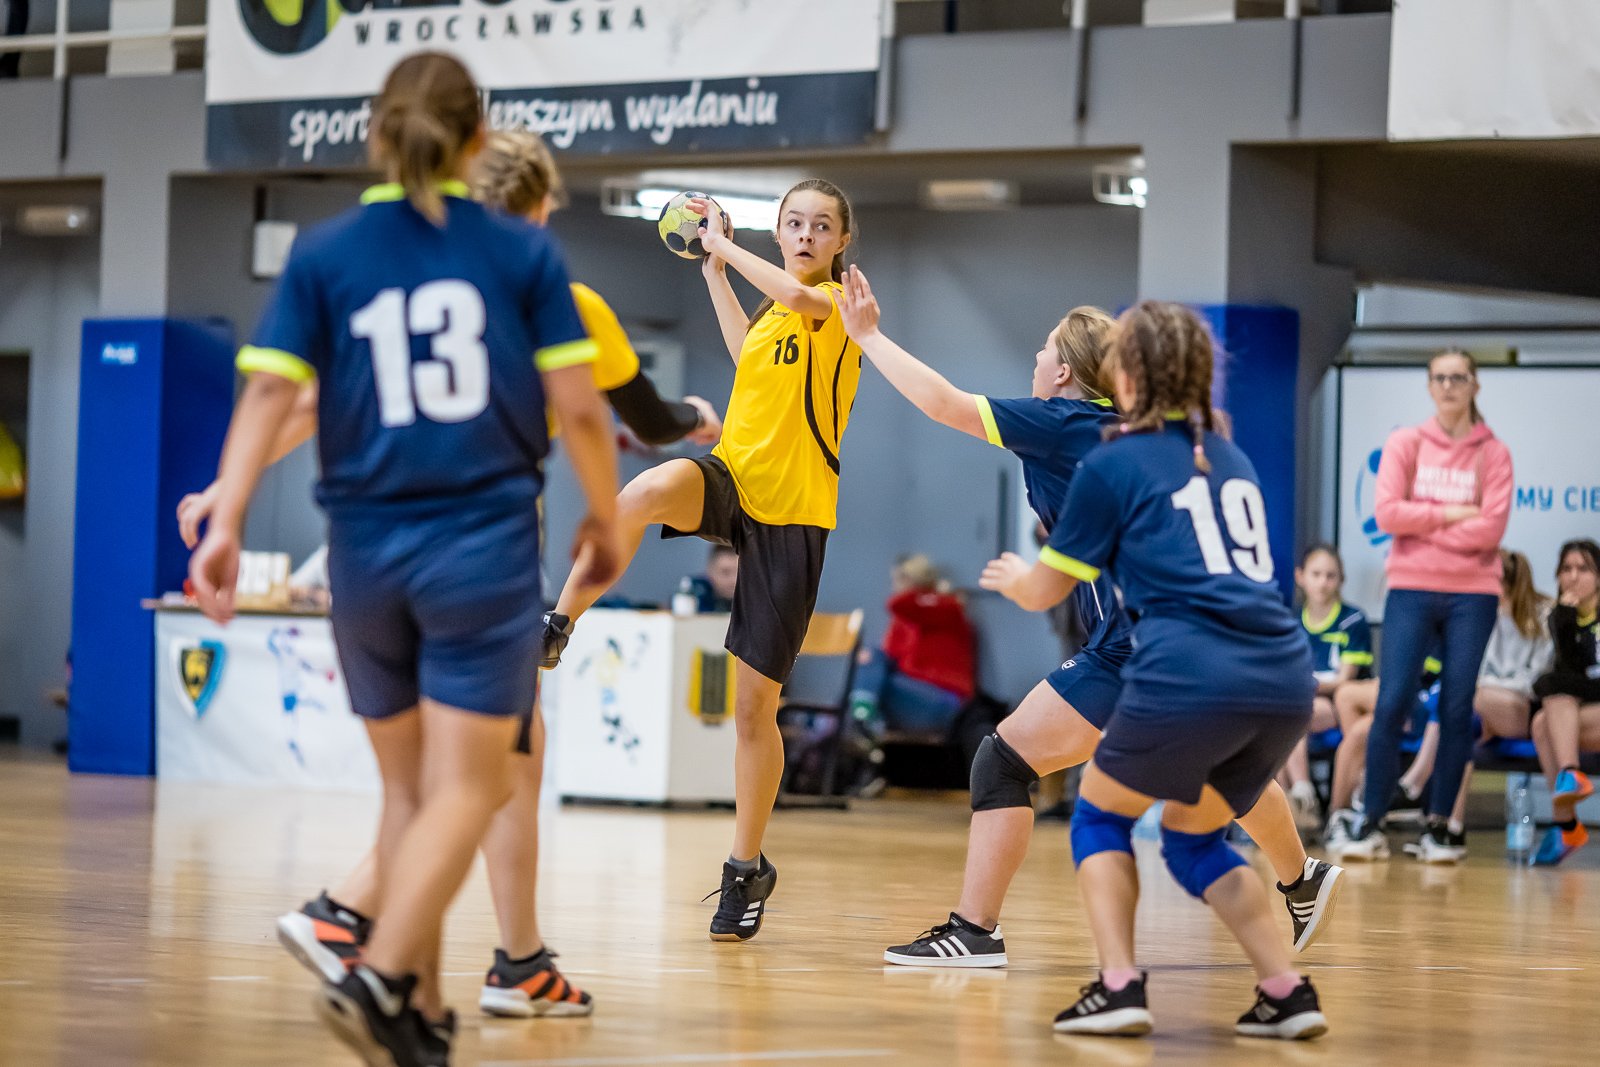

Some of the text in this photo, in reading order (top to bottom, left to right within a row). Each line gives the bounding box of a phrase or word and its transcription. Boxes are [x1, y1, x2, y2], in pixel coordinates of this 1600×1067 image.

[355, 6, 647, 45] WROCŁAWSKA
[288, 100, 374, 163] sport
[625, 78, 779, 145] wydaniu
[349, 277, 491, 428] 13
[774, 333, 800, 366] 16
[1170, 475, 1275, 583] 19
